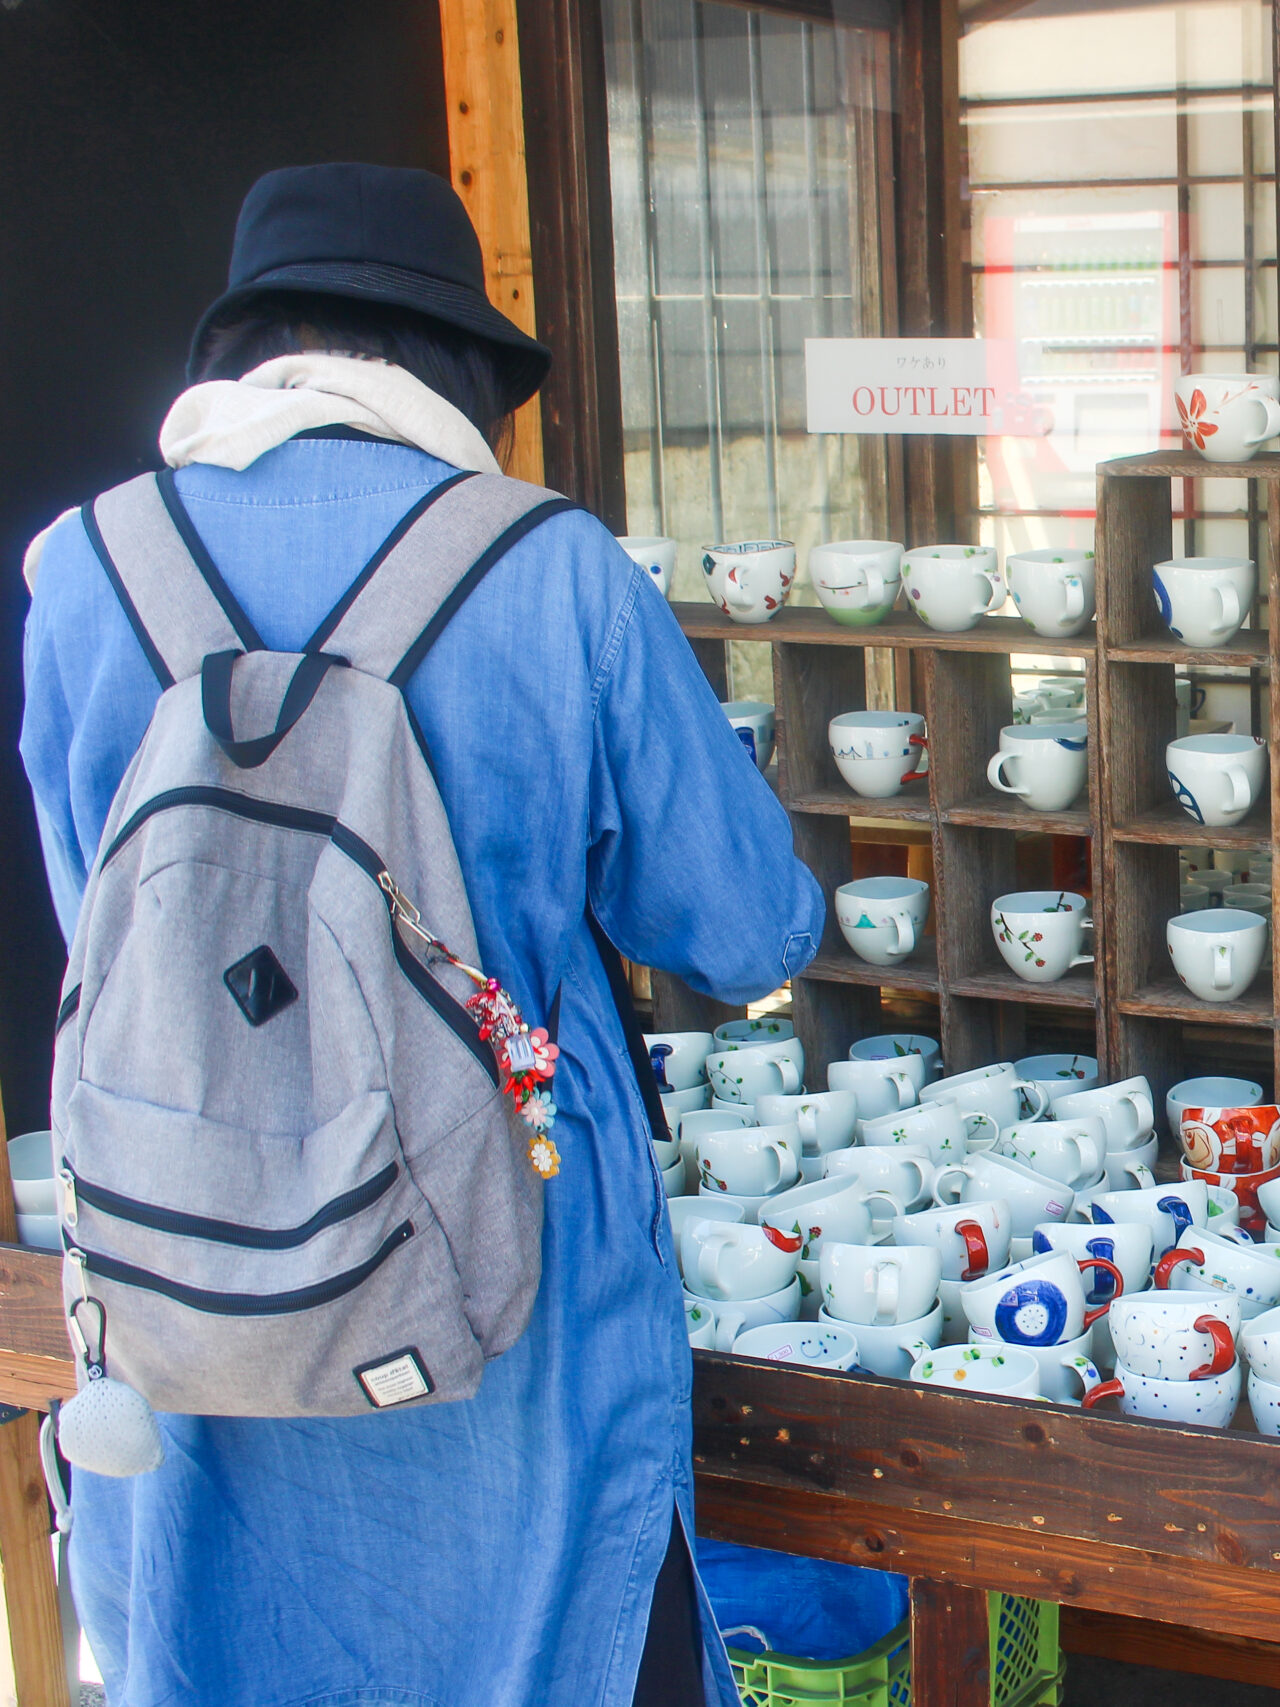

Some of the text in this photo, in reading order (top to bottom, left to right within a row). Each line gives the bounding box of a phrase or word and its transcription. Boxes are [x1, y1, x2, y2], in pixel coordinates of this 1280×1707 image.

[896, 355, 947, 370] ワケあり
[852, 386, 996, 417] OUTLET
